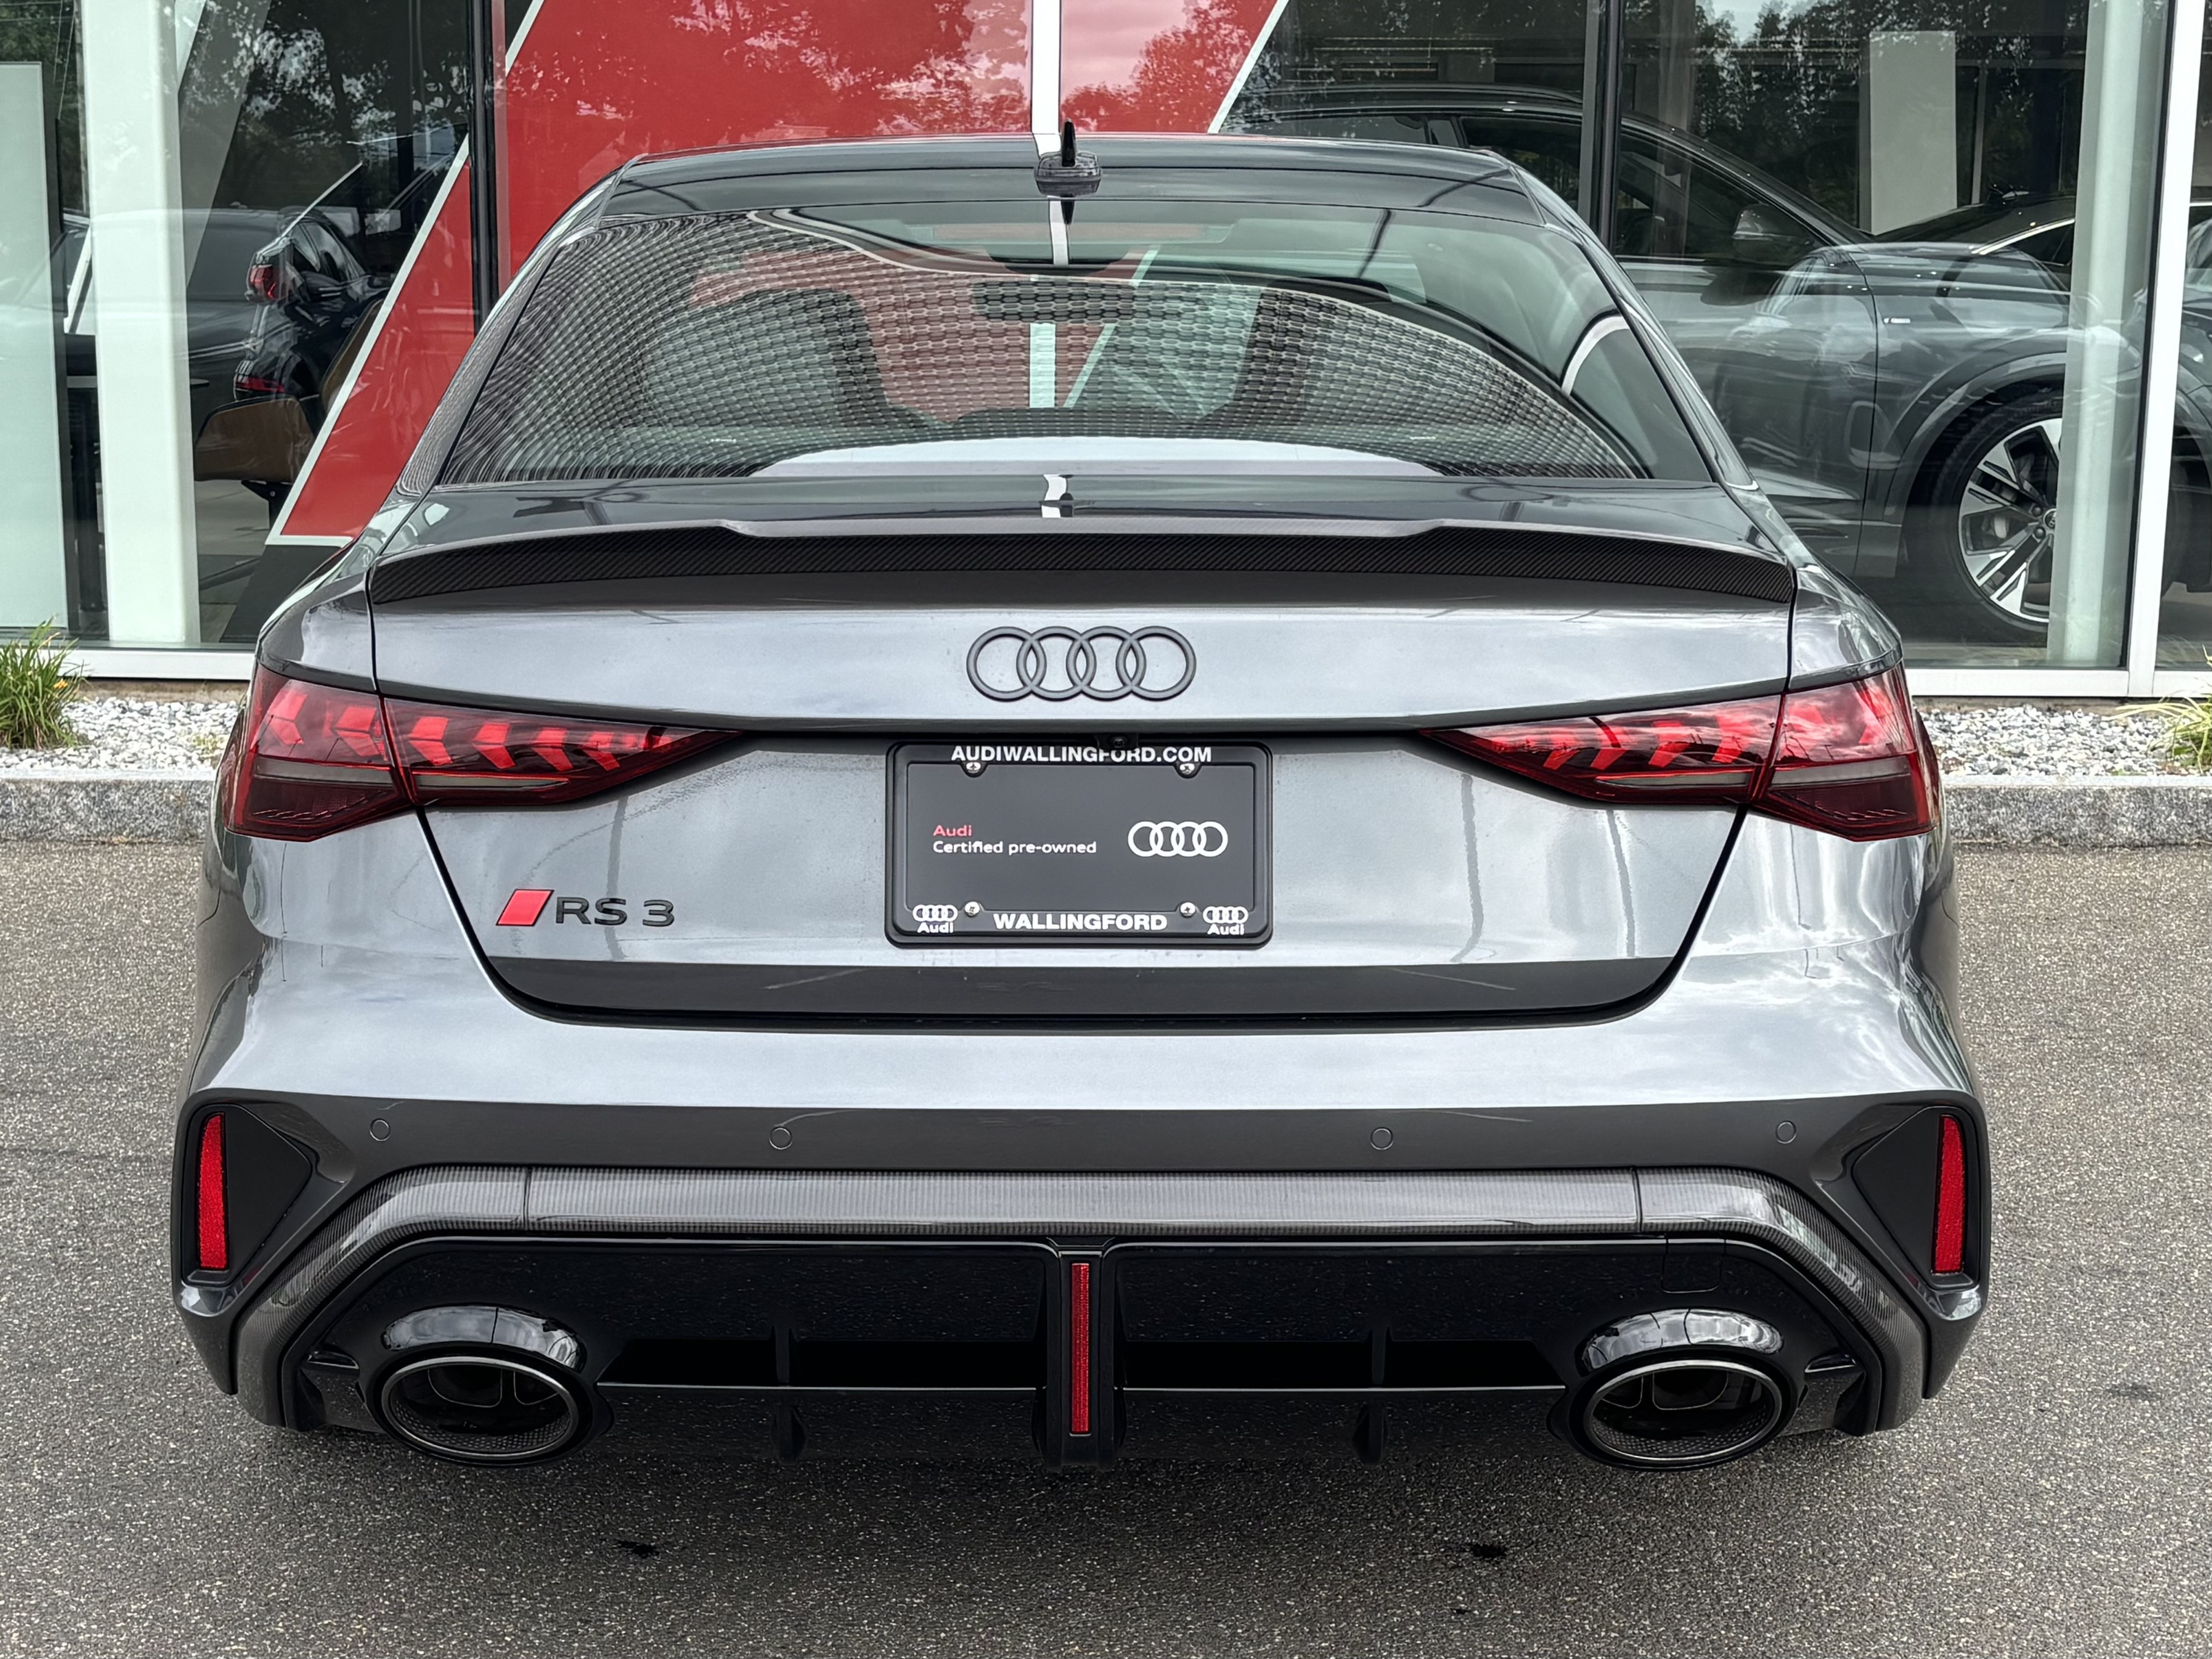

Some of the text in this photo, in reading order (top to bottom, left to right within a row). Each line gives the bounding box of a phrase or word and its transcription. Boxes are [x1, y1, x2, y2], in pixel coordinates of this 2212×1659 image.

[951, 745, 1211, 763] AUDIWALLINGFORD.COM
[933, 825, 972, 837] Audi
[933, 840, 1097, 855] Certified pre-owned
[556, 896, 675, 927] RS 3
[917, 921, 954, 933] Audi
[993, 913, 1168, 931] WALLINGFORD
[1207, 923, 1245, 936] Audi
